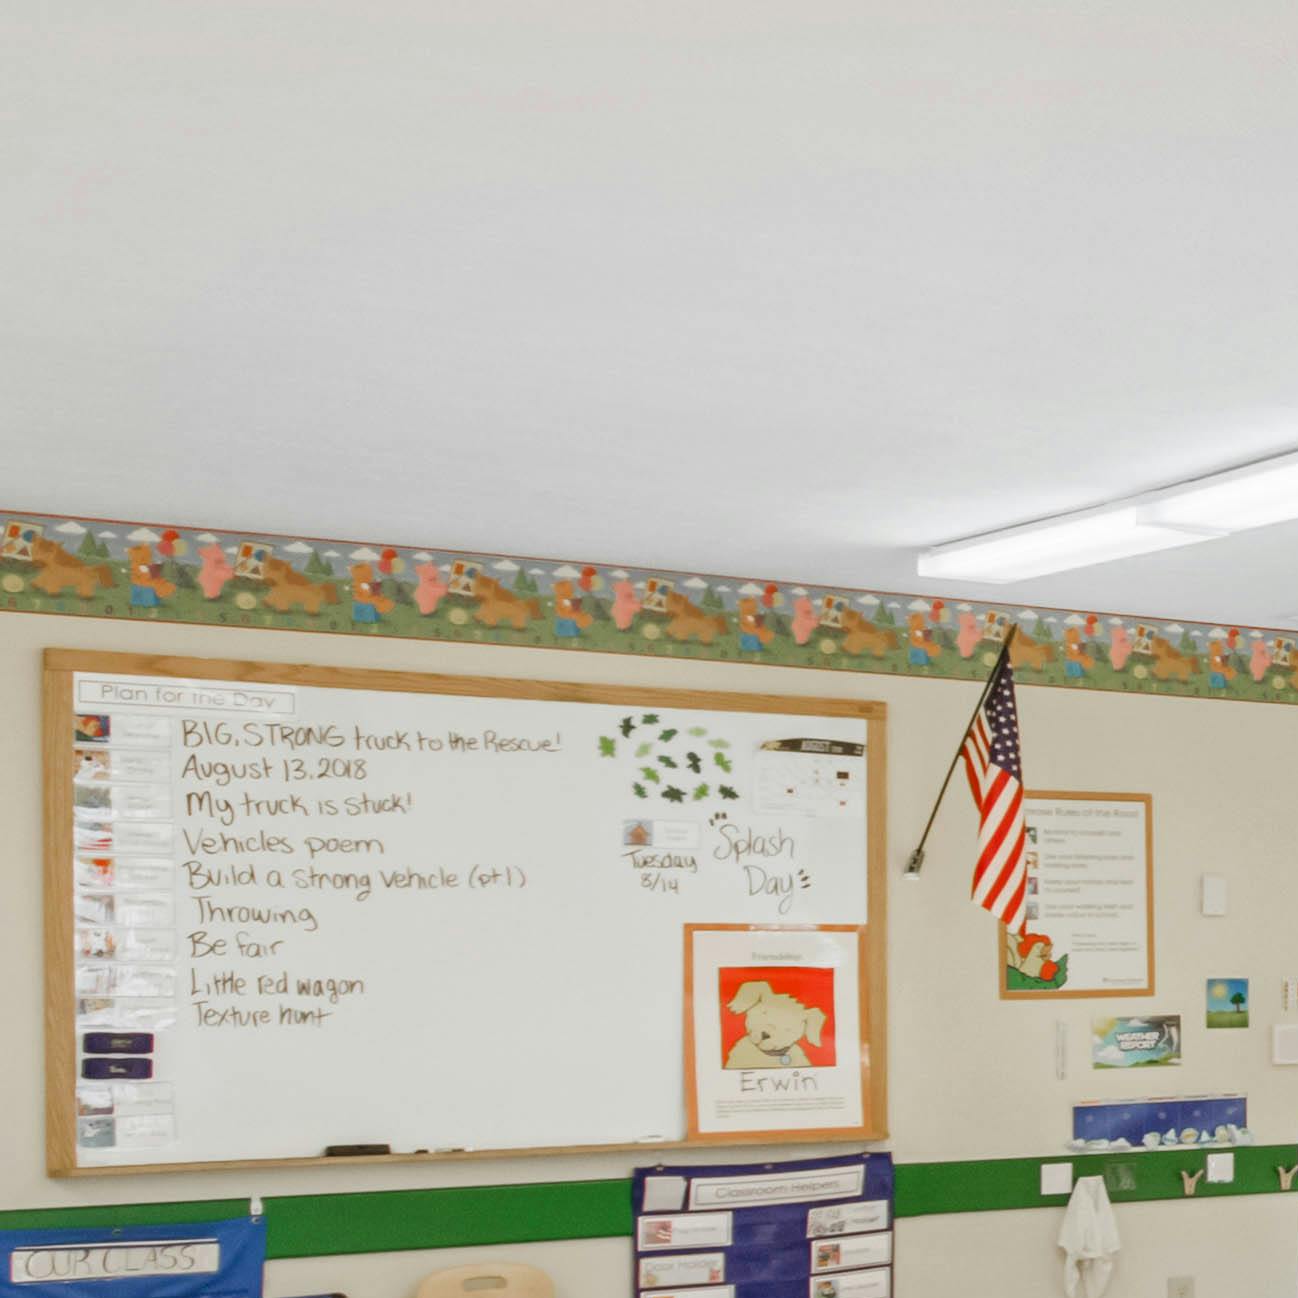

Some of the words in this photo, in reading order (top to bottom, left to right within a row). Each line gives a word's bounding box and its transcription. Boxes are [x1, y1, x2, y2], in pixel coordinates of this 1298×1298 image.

[101, 684, 148, 701] Plan
[156, 687, 182, 703] for
[233, 692, 276, 709] Day
[243, 722, 345, 750] STRONG
[354, 725, 411, 751] truck
[417, 731, 443, 751] to
[448, 730, 479, 751] the
[483, 729, 562, 754] Rescue!
[181, 753, 273, 787] August
[186, 790, 235, 827] My
[240, 791, 310, 817] truck
[318, 799, 339, 817] is
[182, 828, 295, 856] Vehicles
[304, 836, 385, 859] poem
[713, 823, 795, 863] Splash
[182, 860, 257, 890] Build
[266, 870, 285, 889] a
[620, 849, 698, 873] Tuesday
[640, 872, 679, 895] 8/14
[743, 864, 794, 915] Day
[190, 895, 319, 932] Throwing
[186, 931, 228, 958] Be
[190, 966, 247, 997] Little
[257, 970, 289, 997] red
[296, 977, 365, 1005] wagon
[192, 1000, 272, 1028] Texture
[279, 1003, 333, 1027] hunt
[740, 1070, 819, 1093] Erwin
[25, 1248, 92, 1279] OUR
[102, 1243, 197, 1274] CLASS
